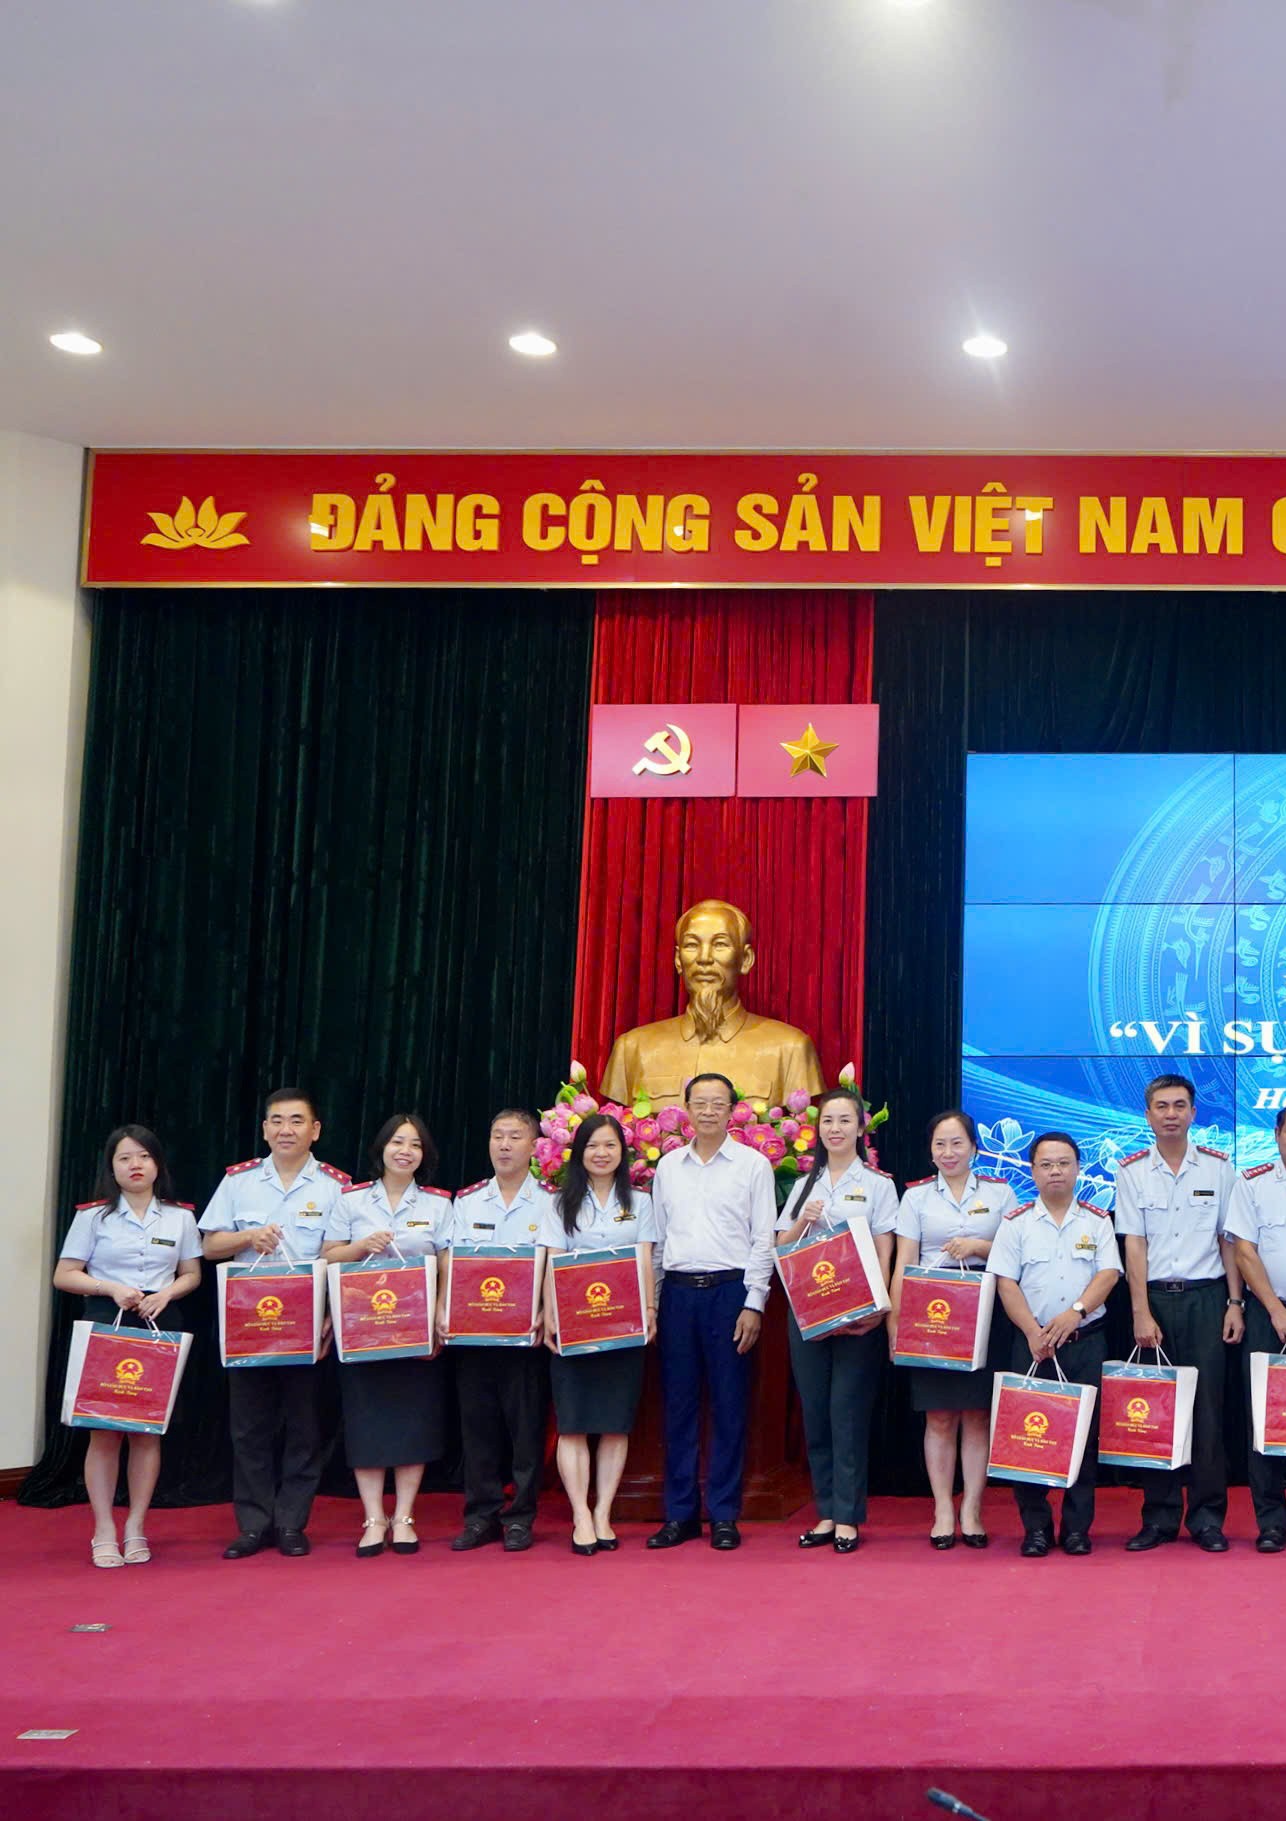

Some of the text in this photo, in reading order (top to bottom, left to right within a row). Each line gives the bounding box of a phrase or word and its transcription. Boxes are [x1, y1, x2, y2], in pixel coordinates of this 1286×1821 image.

[308, 473, 500, 551] ĐẢNG
[522, 480, 710, 565] CỘNG
[735, 472, 881, 552] SẢN
[909, 481, 1053, 567] VIỆT
[1080, 496, 1244, 555] NAM
